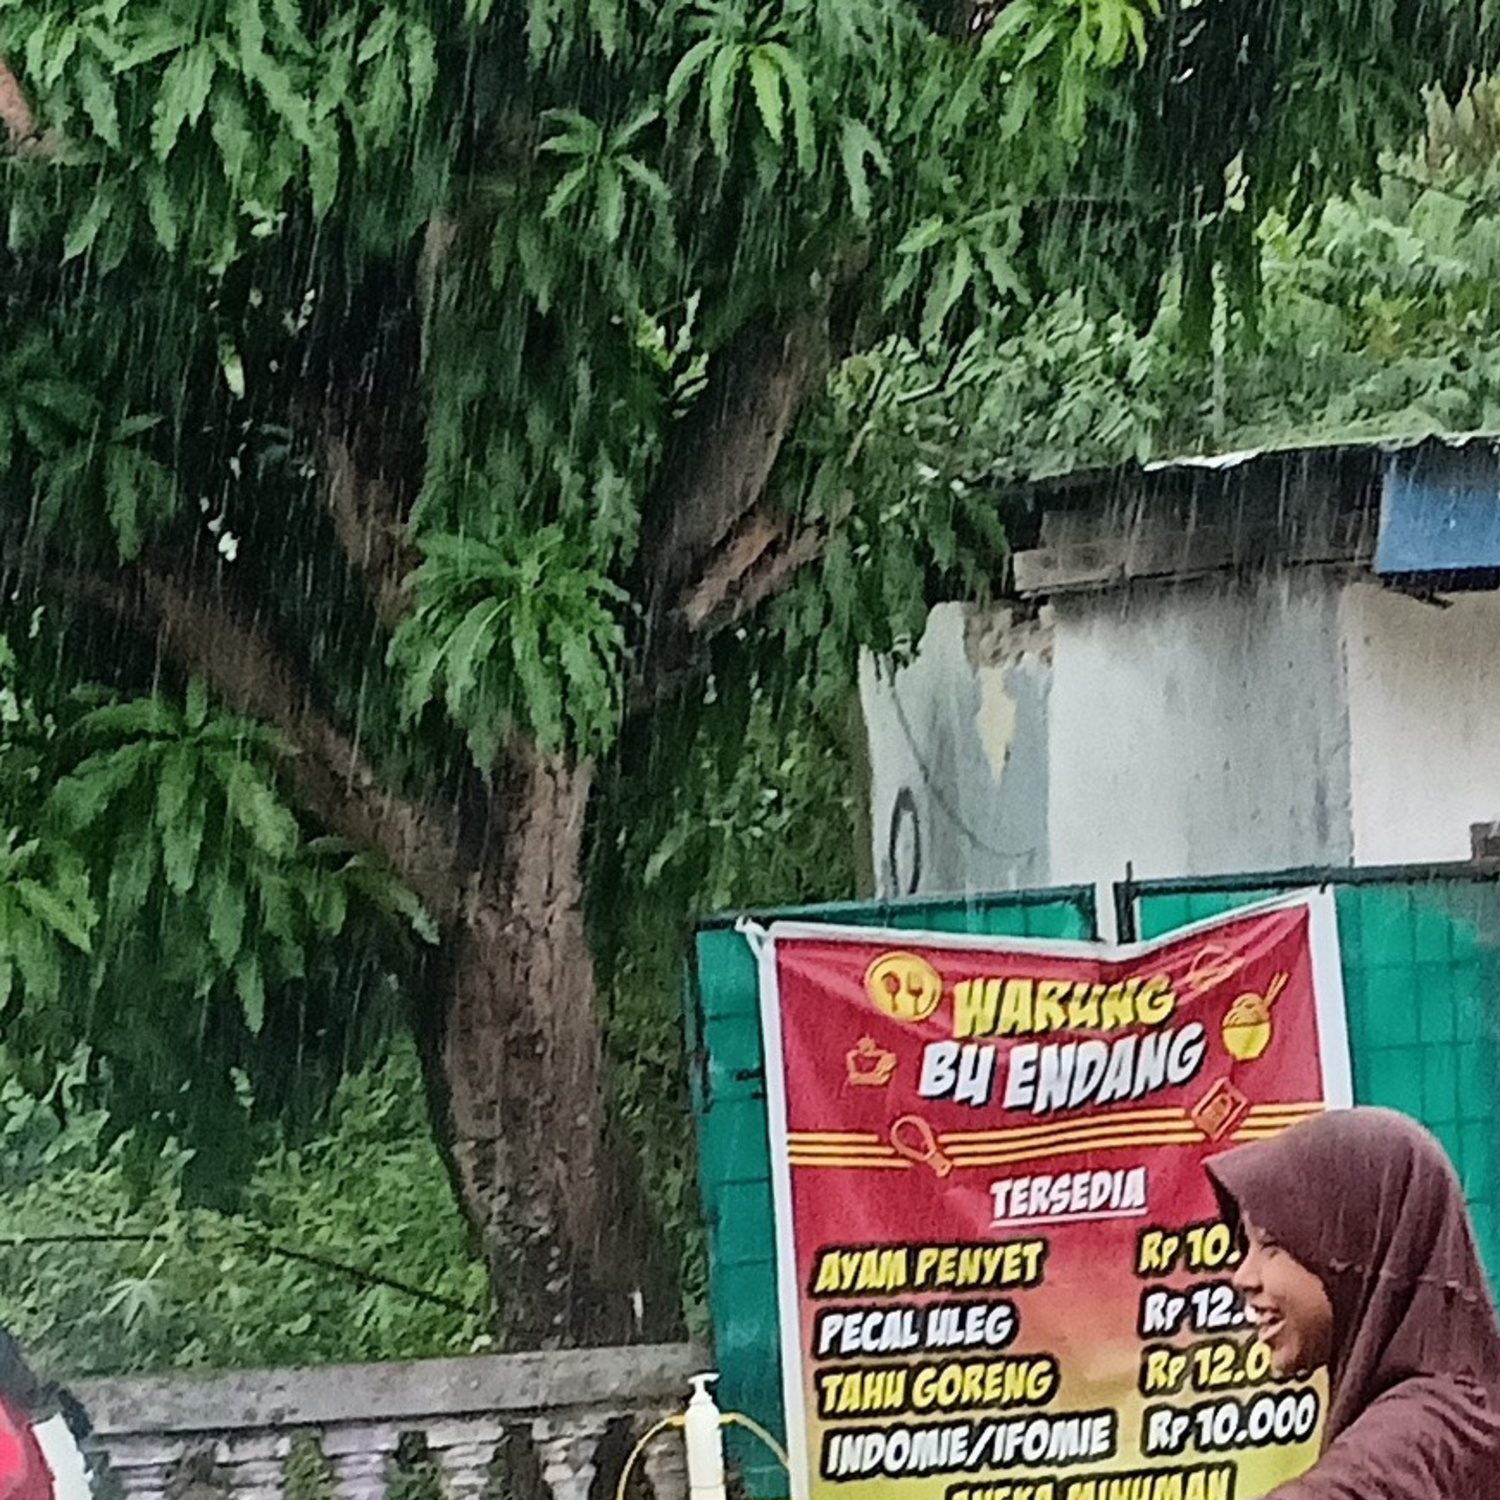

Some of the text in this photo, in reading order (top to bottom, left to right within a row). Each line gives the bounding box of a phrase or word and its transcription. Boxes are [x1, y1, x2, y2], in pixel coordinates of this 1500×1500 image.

[951, 972, 1178, 1039] WARUNG
[917, 1022, 1208, 1114] BU ENDANG
[989, 1167, 1150, 1220] TERSEDIA
[813, 1247, 909, 1296] AYAM
[912, 1239, 1045, 1290] PENYET
[1140, 1230, 1180, 1273] Rp
[818, 1307, 920, 1357] PECAL
[925, 1303, 1015, 1348] ULEG
[1142, 1291, 1186, 1335] Rp
[820, 1369, 910, 1414] TAHU
[911, 1358, 1054, 1406] GORENG
[1144, 1350, 1188, 1393] Rp
[824, 1392, 1317, 1477] INDOMIE/IFOMIE Rp 10.000
